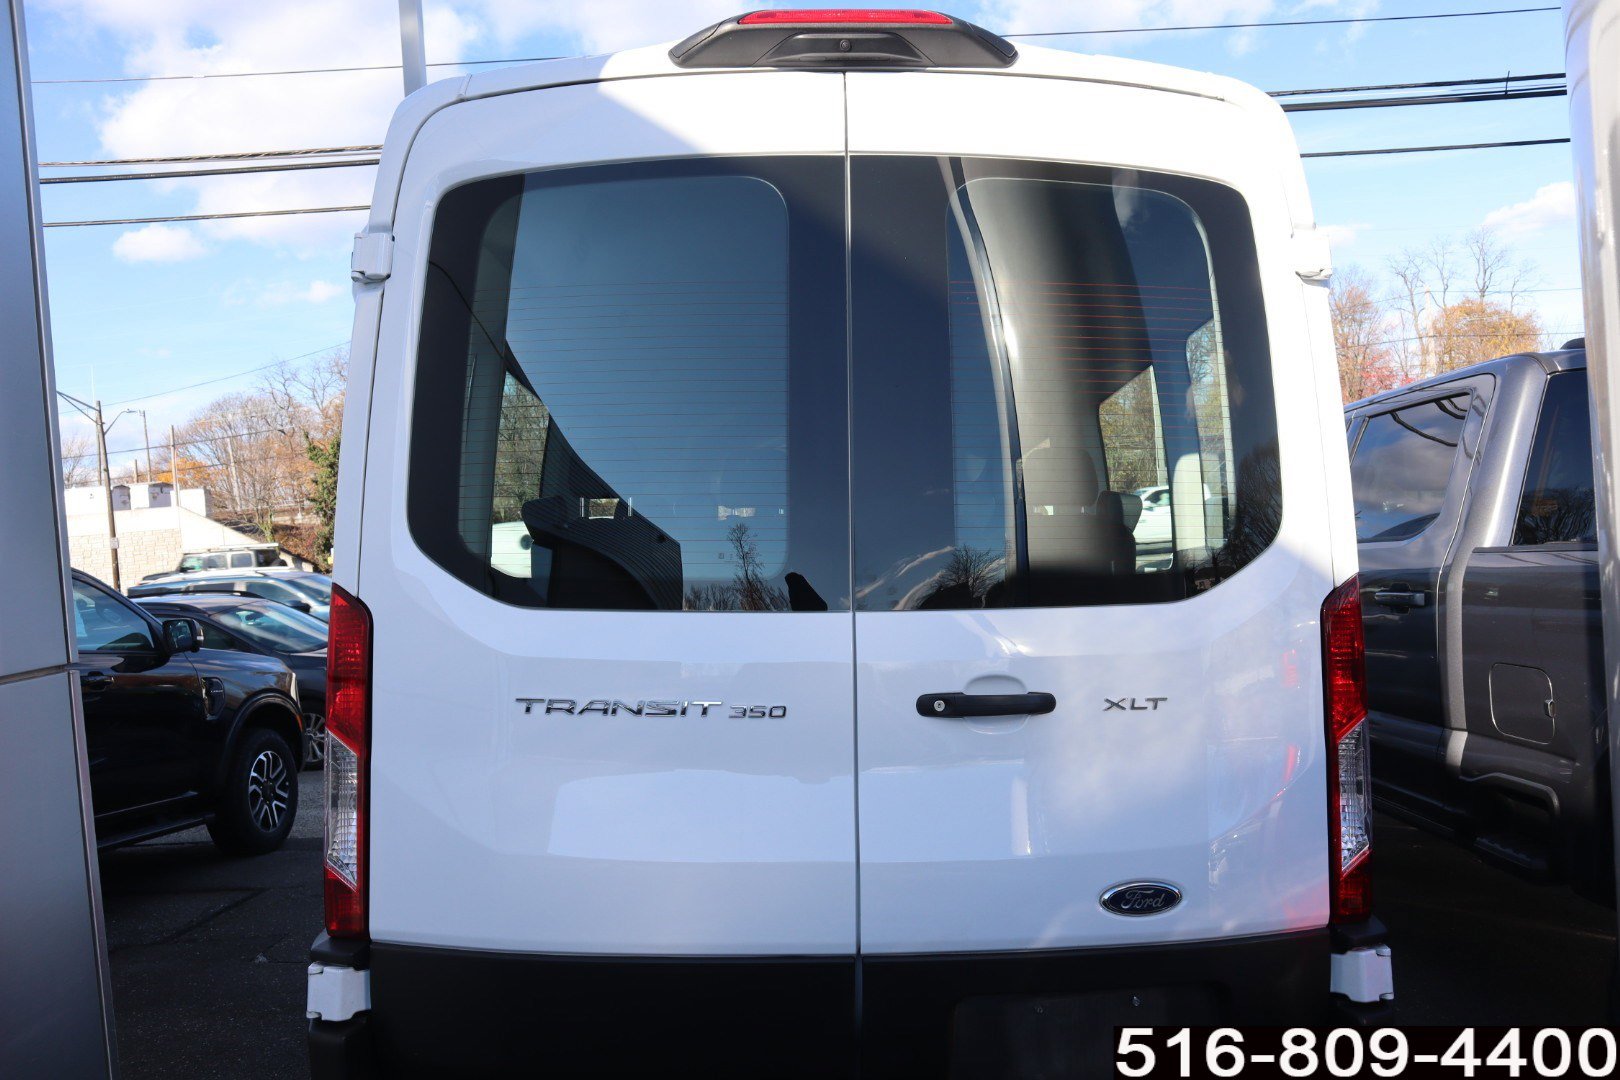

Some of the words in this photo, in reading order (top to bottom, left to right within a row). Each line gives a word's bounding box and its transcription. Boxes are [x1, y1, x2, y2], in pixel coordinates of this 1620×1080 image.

[515, 698, 722, 717] TRANSIT
[728, 705, 787, 719] 350
[1103, 697, 1168, 711] XLT
[1120, 889, 1166, 909] Ford
